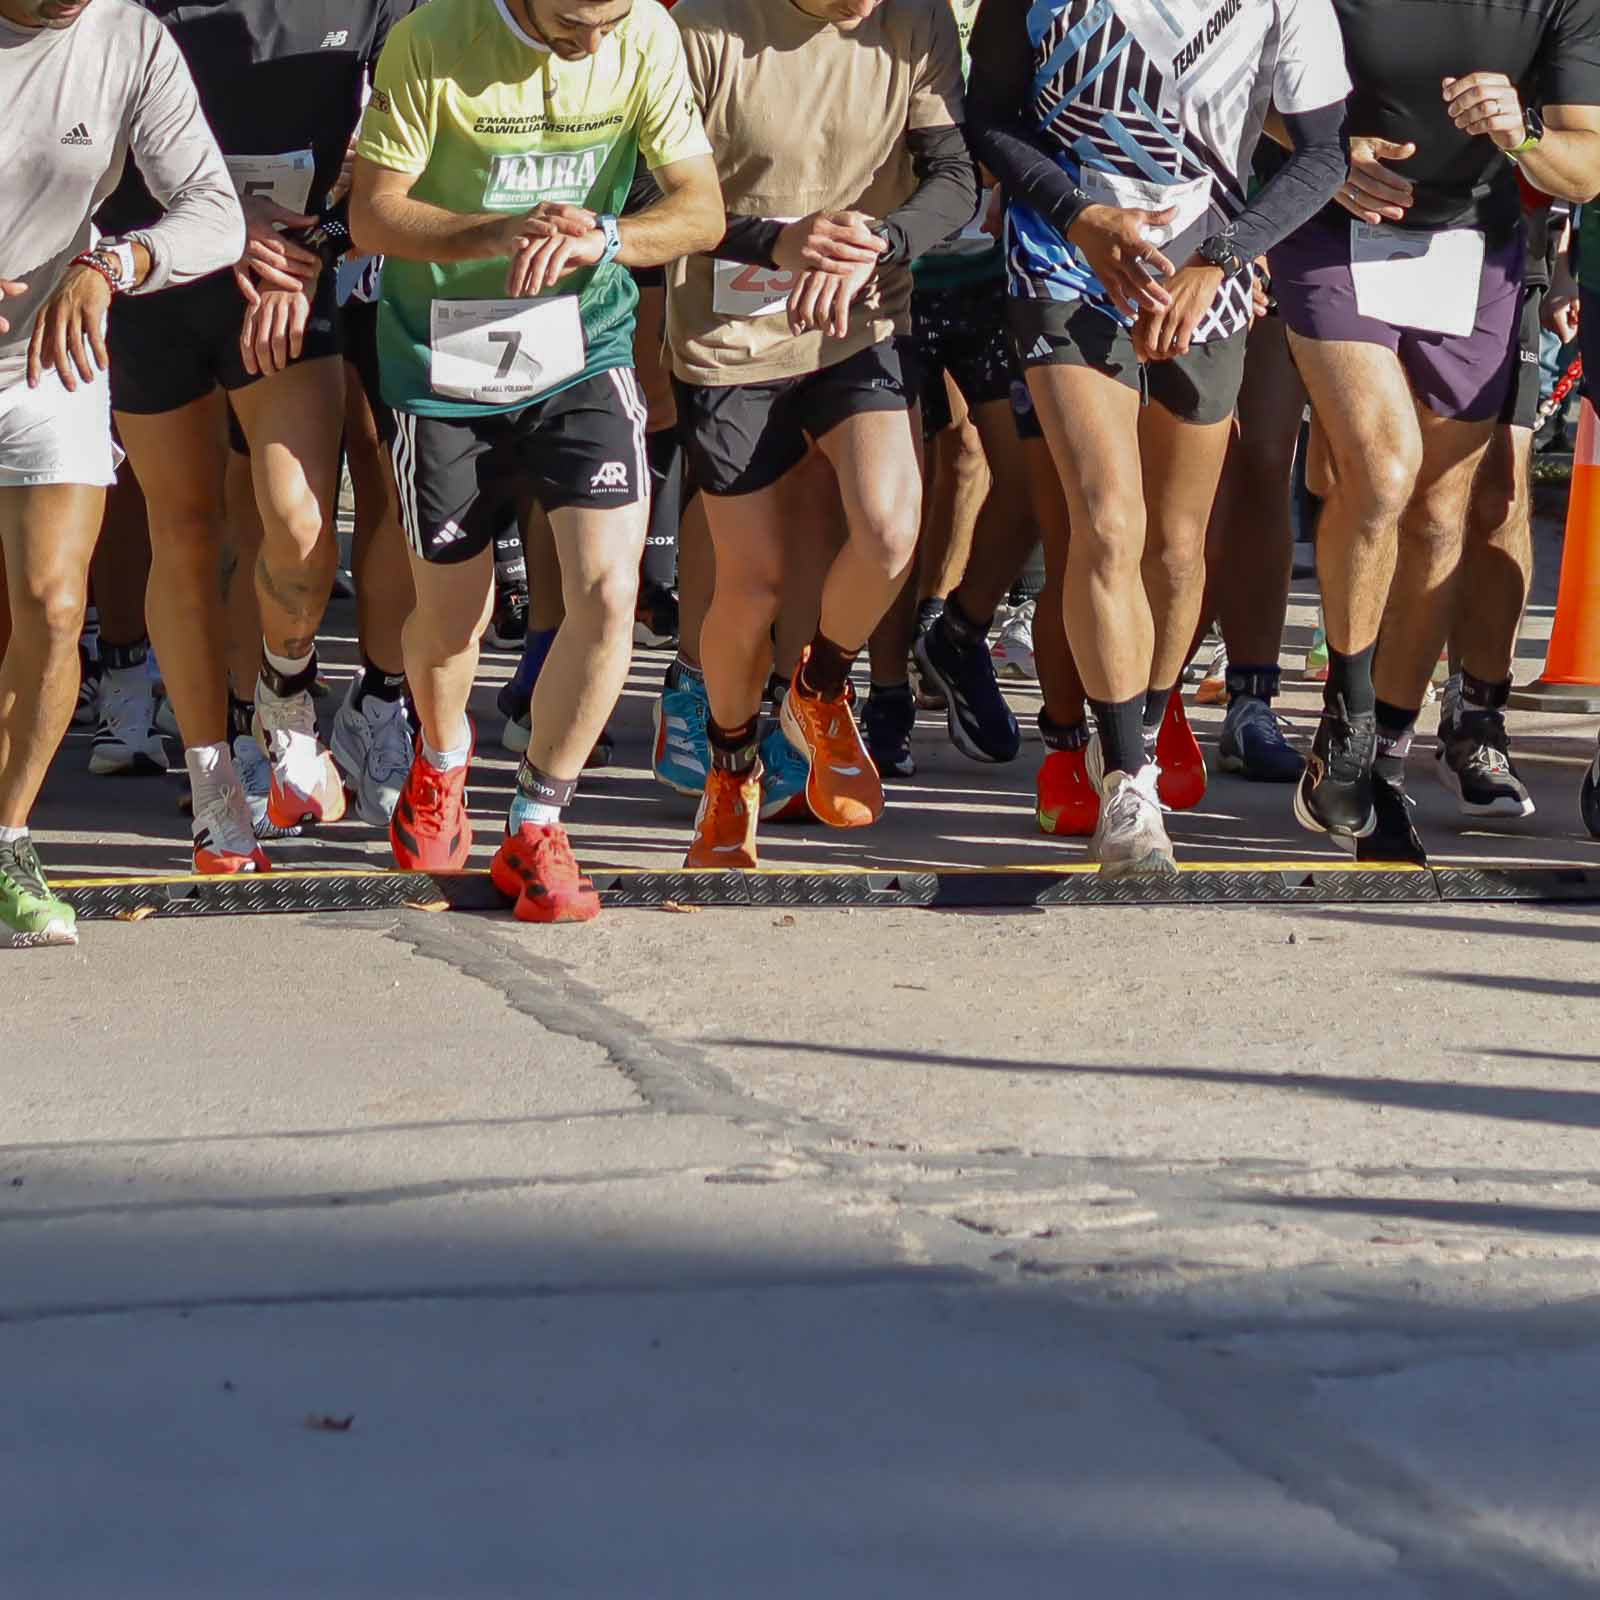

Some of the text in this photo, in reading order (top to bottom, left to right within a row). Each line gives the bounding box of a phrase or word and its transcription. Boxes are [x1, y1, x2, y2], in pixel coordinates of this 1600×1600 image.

[1171, 29, 1205, 81] TEAM
[60, 135, 93, 146] adidas
[487, 330, 522, 379] 7
[871, 377, 901, 389] FILA
